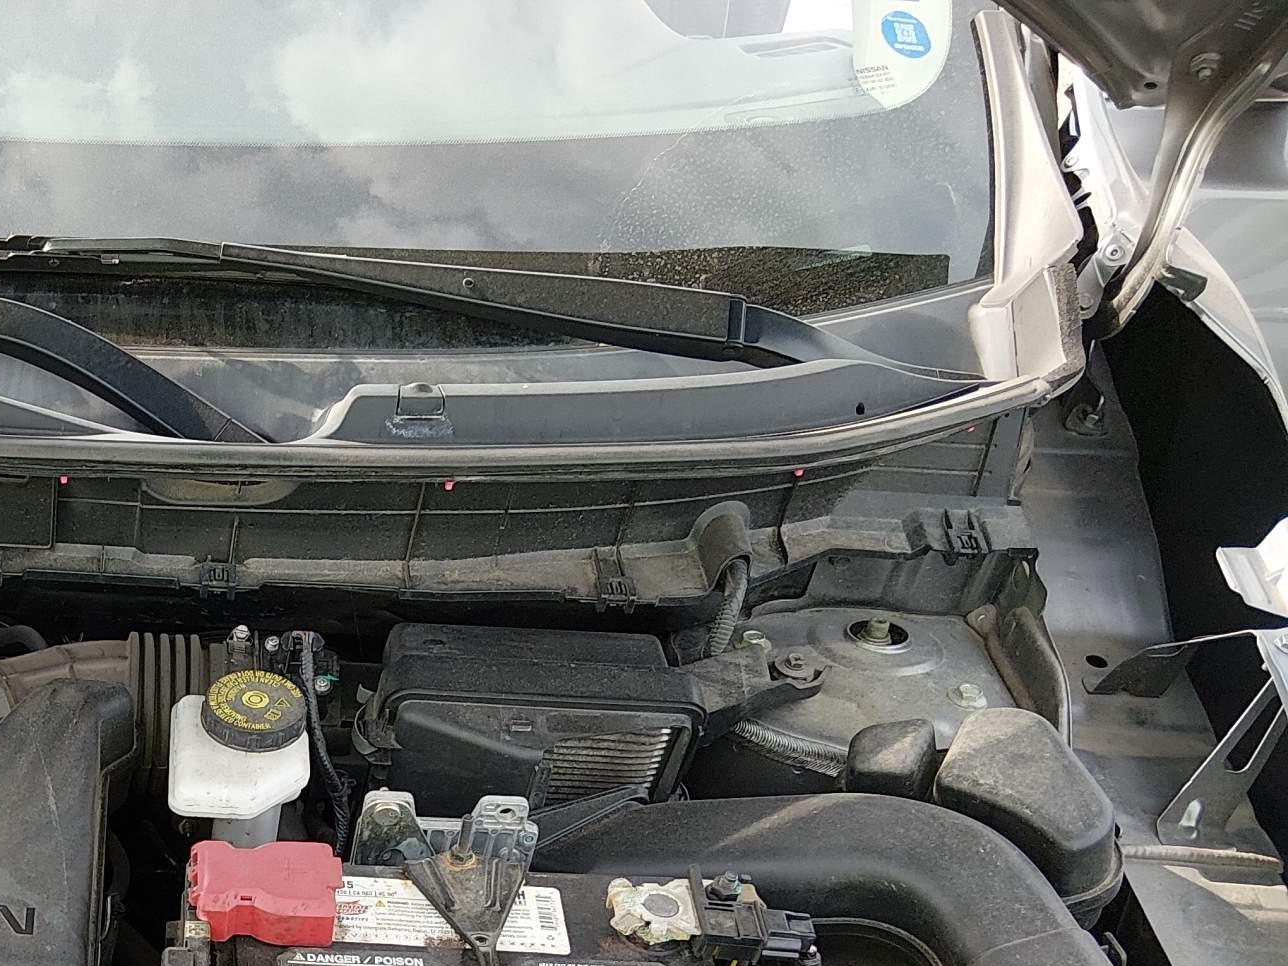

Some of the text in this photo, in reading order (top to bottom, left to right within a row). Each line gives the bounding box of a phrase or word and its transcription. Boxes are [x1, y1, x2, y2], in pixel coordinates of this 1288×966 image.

[306, 954, 424, 966] DANGER / POISON
